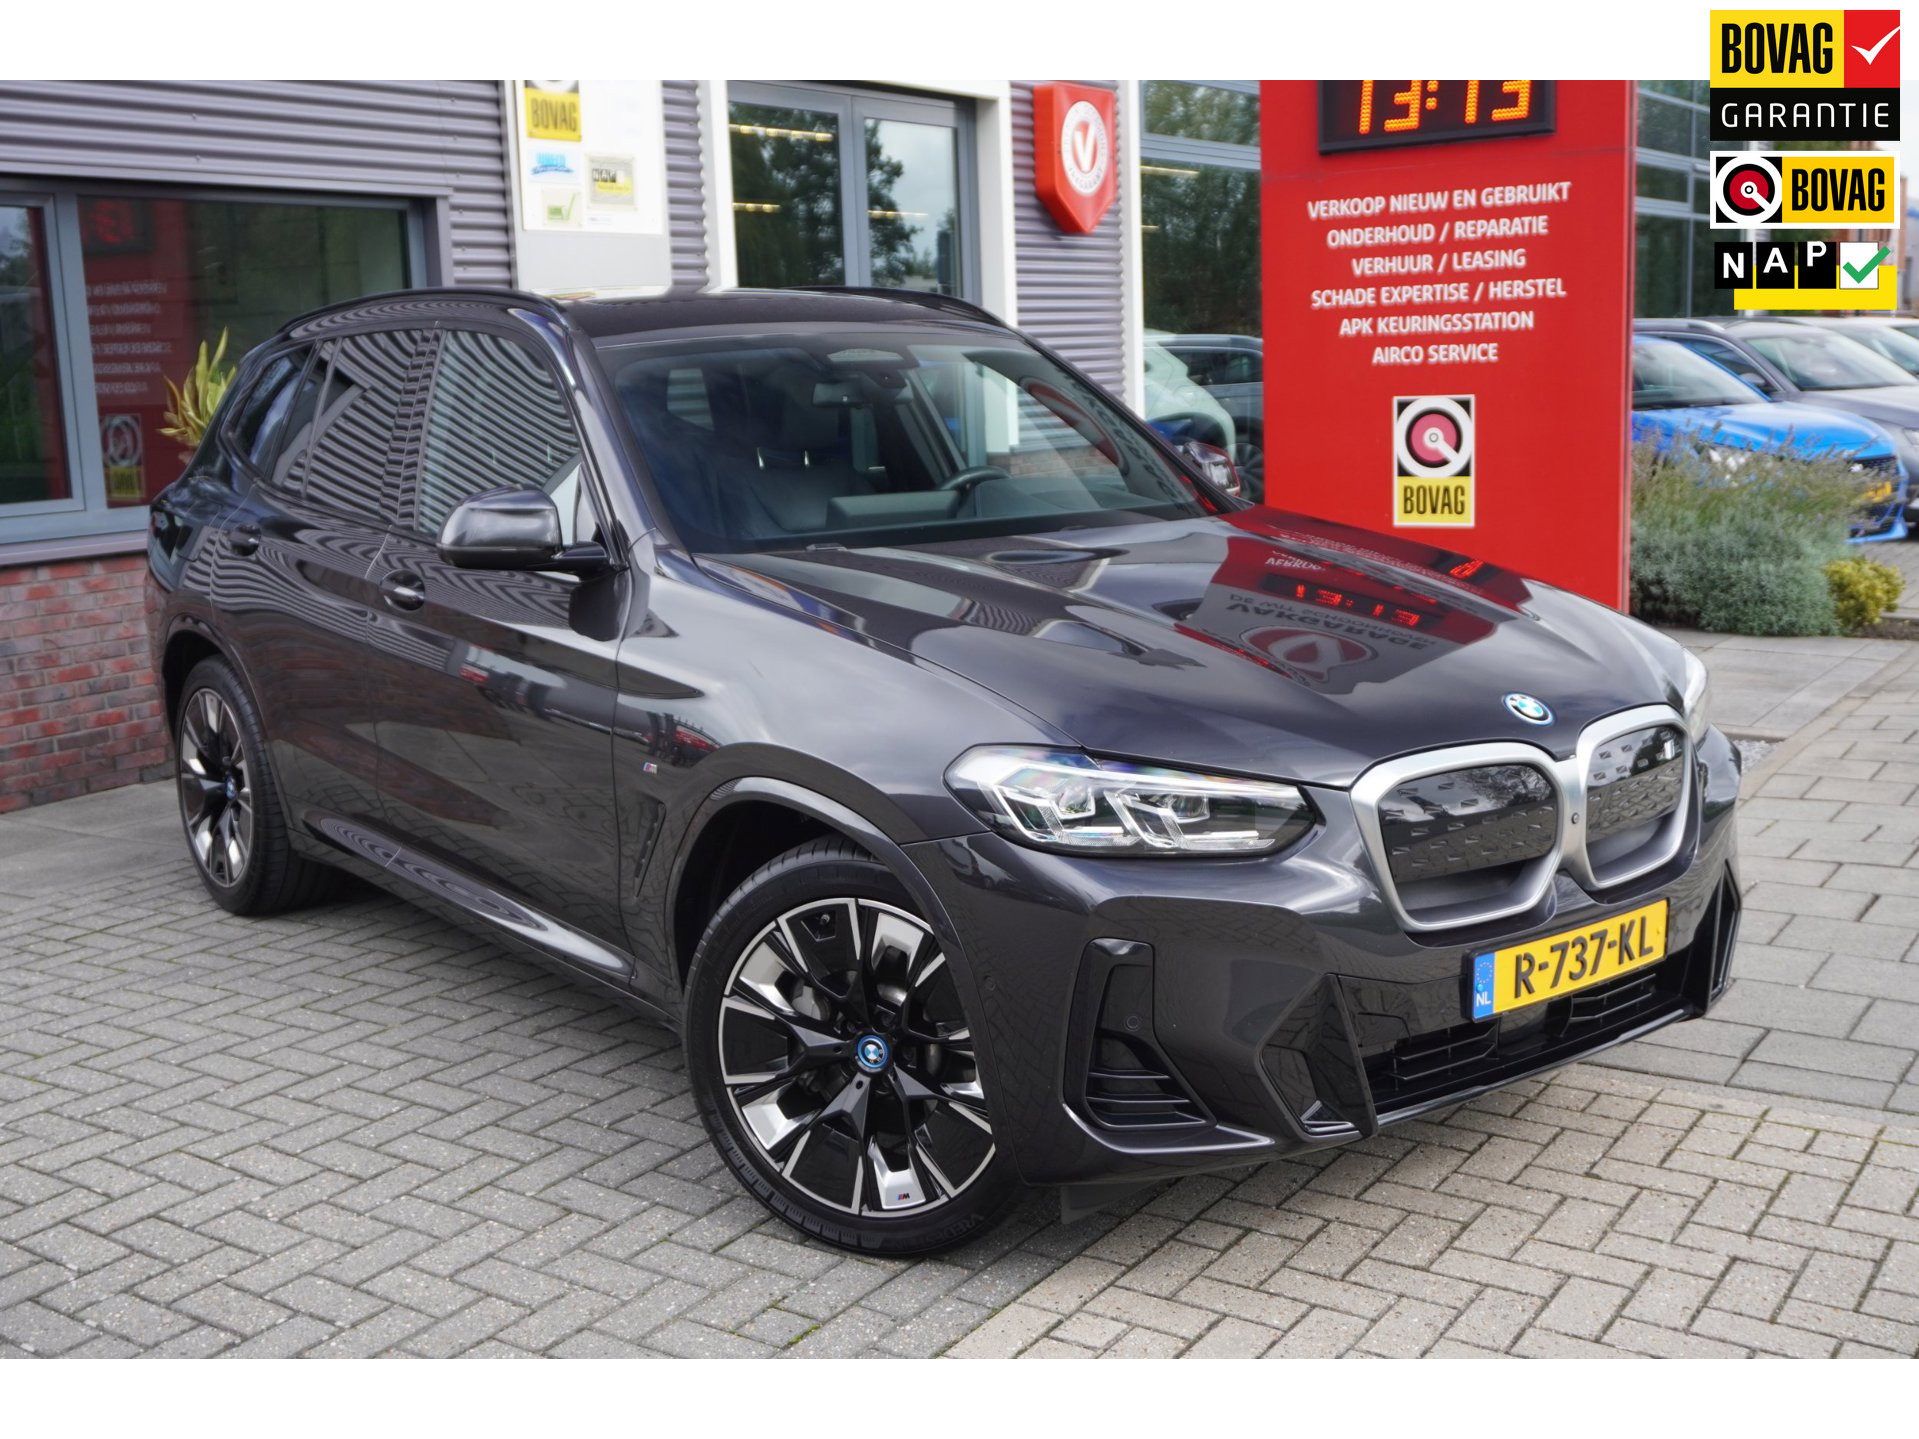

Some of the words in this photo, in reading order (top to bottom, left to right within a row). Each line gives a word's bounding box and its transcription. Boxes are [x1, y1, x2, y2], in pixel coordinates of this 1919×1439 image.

[530, 97, 578, 132] BOVAG
[1308, 195, 1386, 219] VERKOOP
[1390, 191, 1448, 213] NIEUW
[1453, 188, 1476, 209] EN
[1481, 182, 1571, 207] GEBRUIKT
[1327, 223, 1435, 248] ONDERHOUD
[1440, 222, 1450, 243] /
[1454, 215, 1548, 240] REPARATIE
[1352, 254, 1433, 277] VERHUUR
[1438, 253, 1448, 273] /
[1453, 248, 1526, 271] LEASING
[1312, 288, 1376, 308] SCHADE
[1381, 283, 1469, 305] EXPERTISE
[1474, 282, 1484, 303] /
[1489, 278, 1566, 299] HERSTEL
[1340, 318, 1373, 336] APK
[1377, 311, 1534, 335] KEURINGSSTATION
[1372, 345, 1424, 365] AIRCO
[1428, 343, 1498, 364] SERVICE
[1403, 485, 1465, 515] BOVAG
[1514, 915, 1654, 999] R-737-KL
[1476, 991, 1492, 1007] NL
